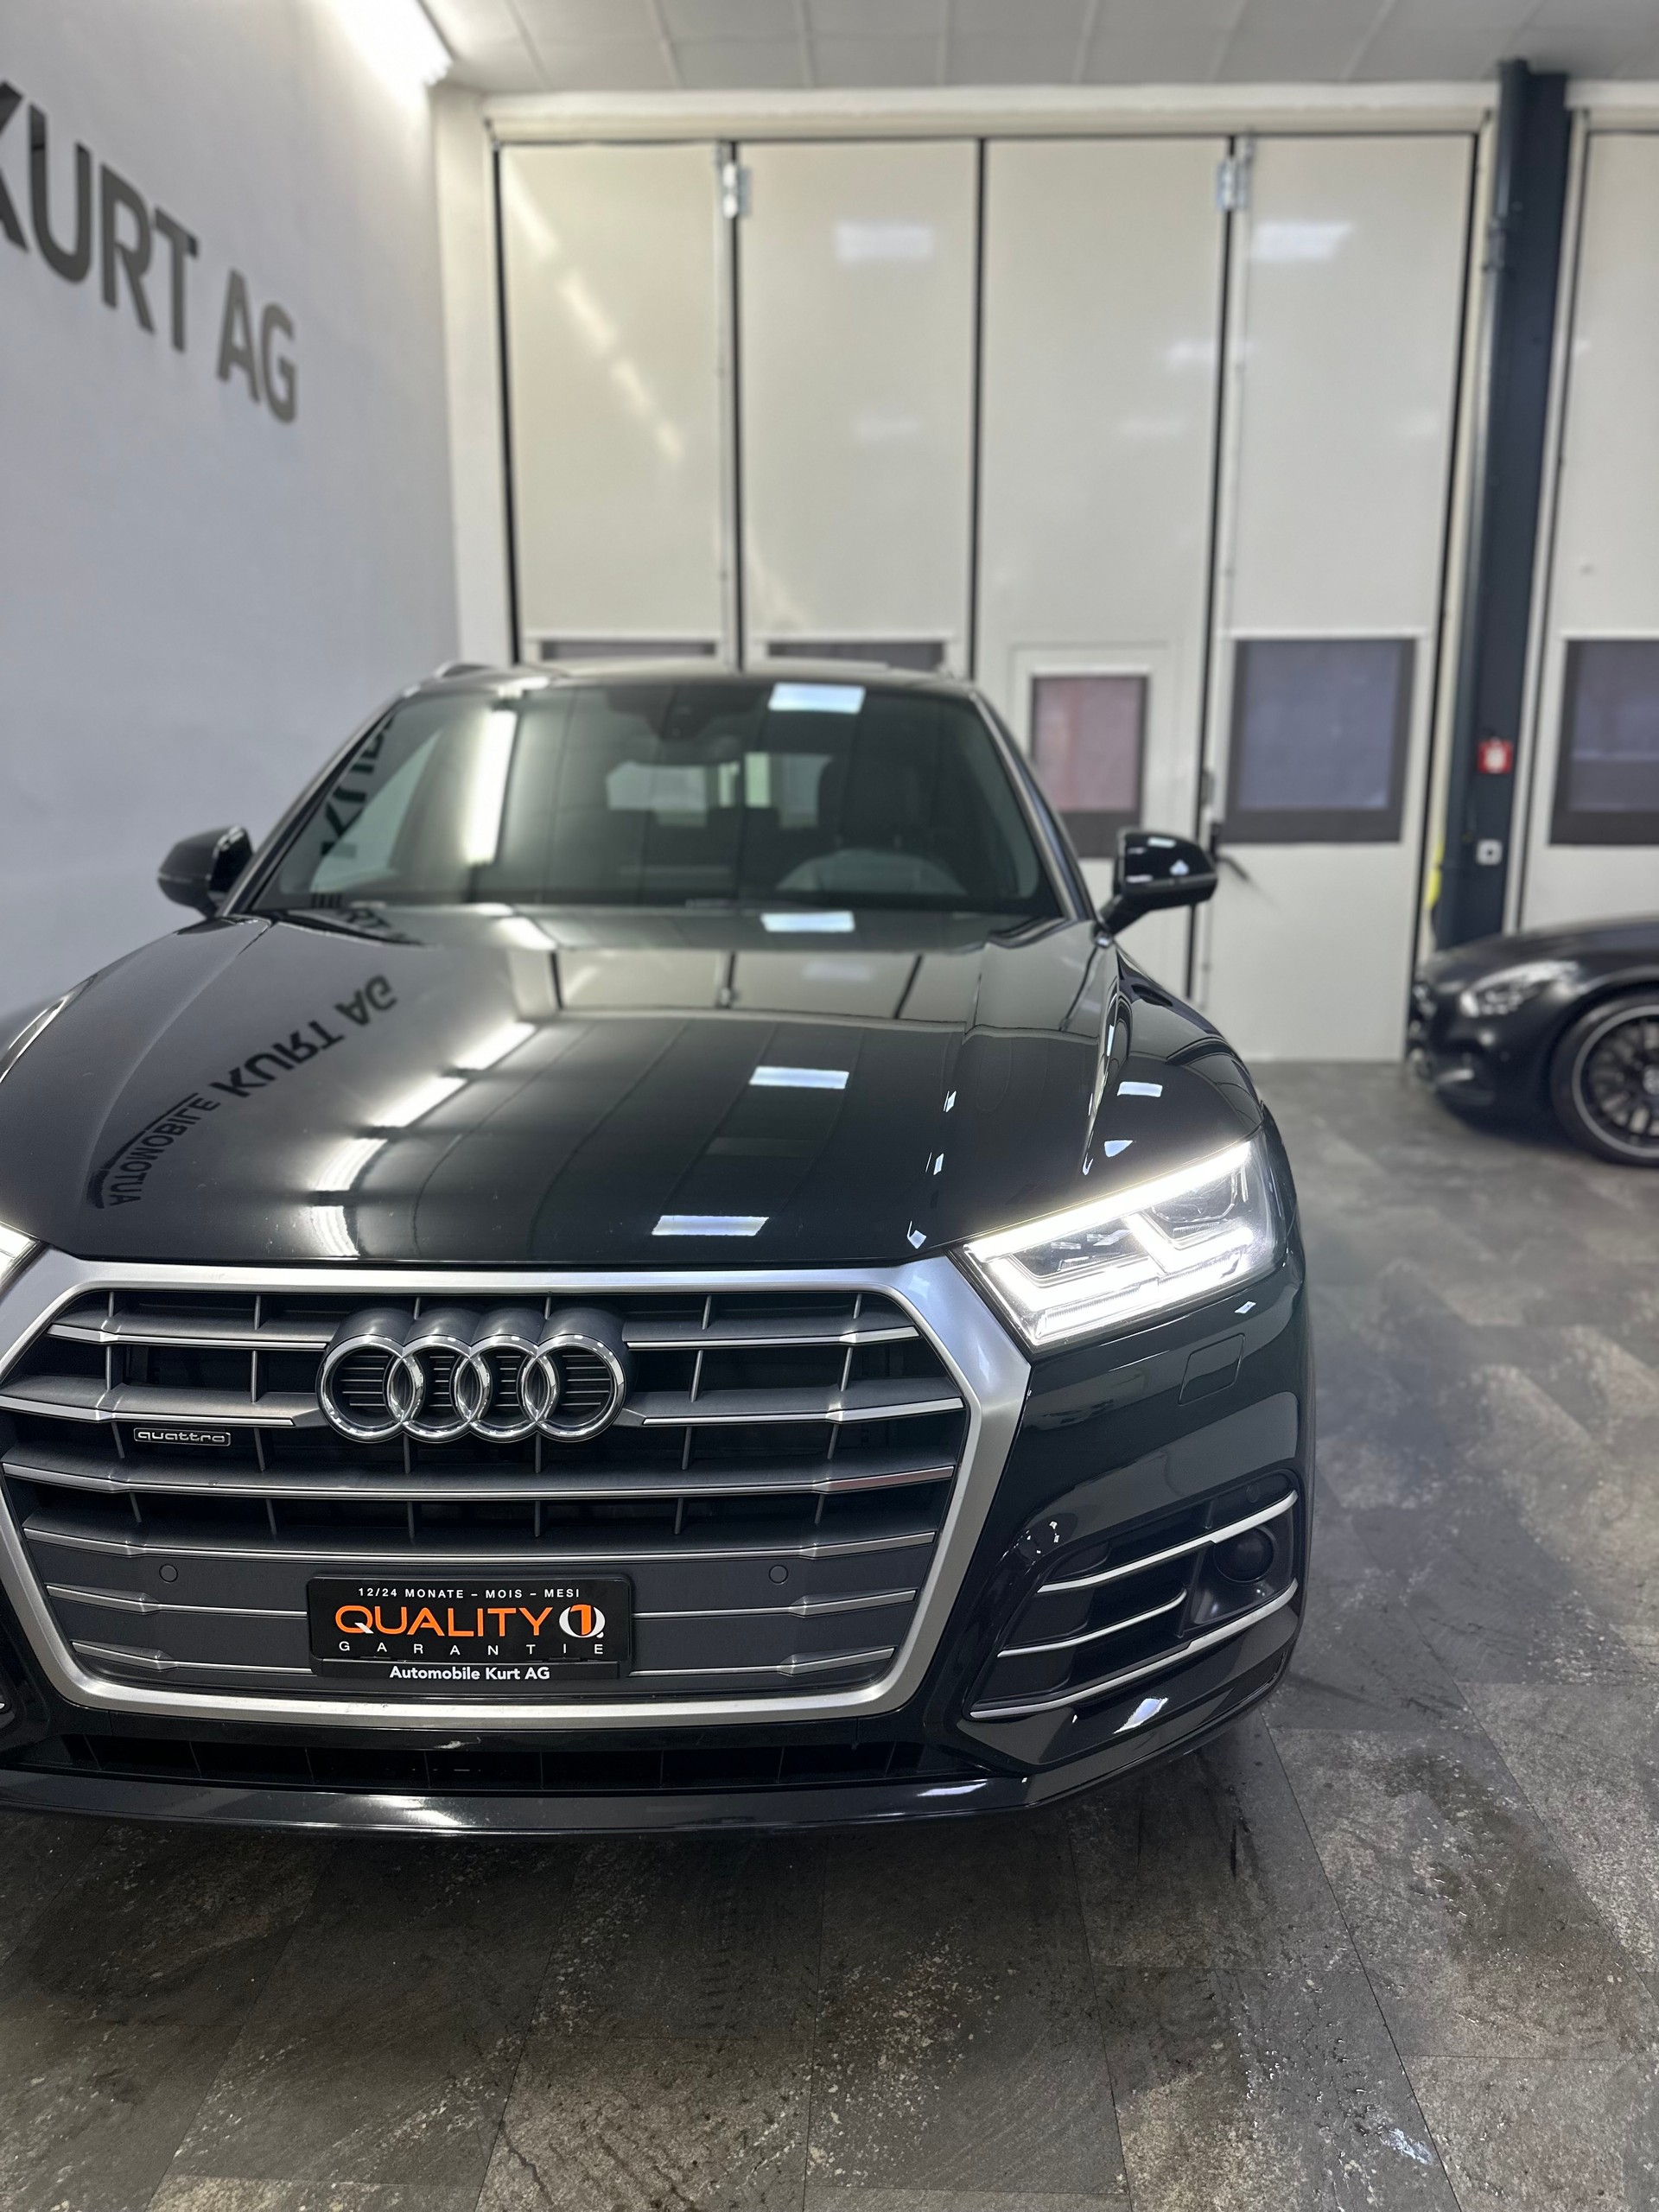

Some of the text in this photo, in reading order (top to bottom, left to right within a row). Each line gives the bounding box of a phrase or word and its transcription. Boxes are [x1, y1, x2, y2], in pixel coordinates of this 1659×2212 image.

[216, 268, 296, 424] AG
[137, 1431, 226, 1442] quattro
[358, 1586, 398, 1598] 12/24
[404, 1588, 464, 1599] MONATE
[485, 1588, 524, 1599] MOIS
[544, 1588, 580, 1598] MESI
[334, 1605, 554, 1637] QUALITY
[338, 1641, 604, 1656] GARANTIE
[389, 1666, 550, 1681] Automobile Kurt AG
